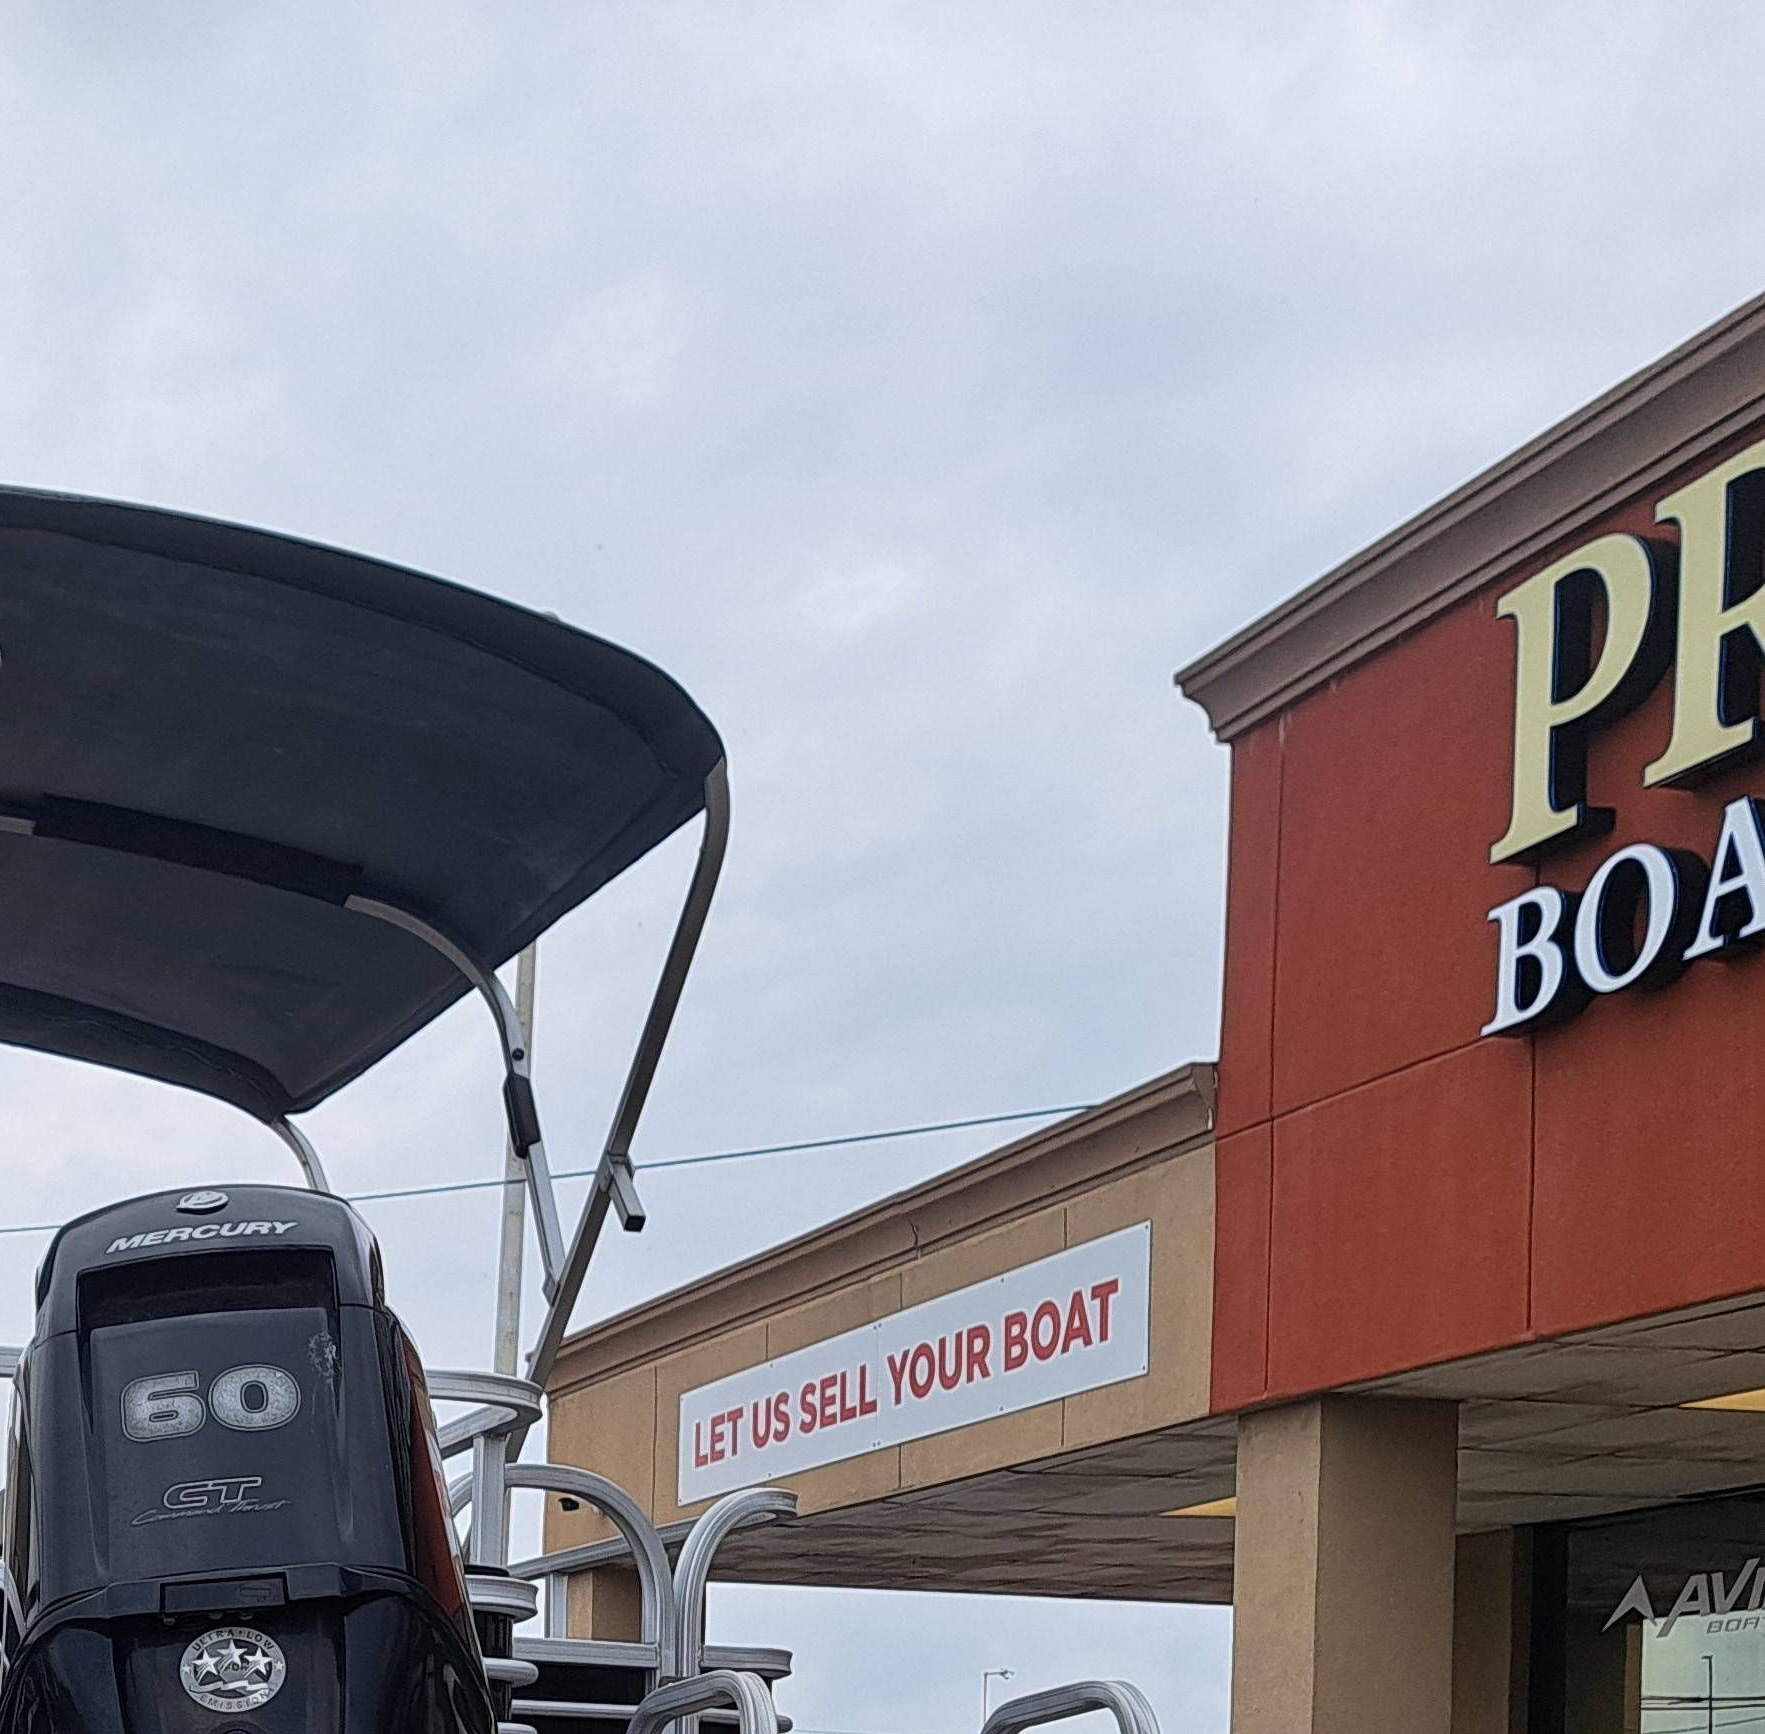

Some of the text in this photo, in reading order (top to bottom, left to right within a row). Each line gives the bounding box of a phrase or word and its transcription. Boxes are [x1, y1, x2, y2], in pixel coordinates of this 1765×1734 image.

[105, 1221, 299, 1254] MERCURY
[694, 1277, 1120, 1468] LET US SELL YOUR BOAT
[120, 1363, 301, 1442] 60
[163, 1476, 262, 1509] GT
[1656, 1557, 1765, 1638] AVI
[192, 1629, 275, 1652] ULTRA LOW
[1706, 1616, 1765, 1634] BOA
